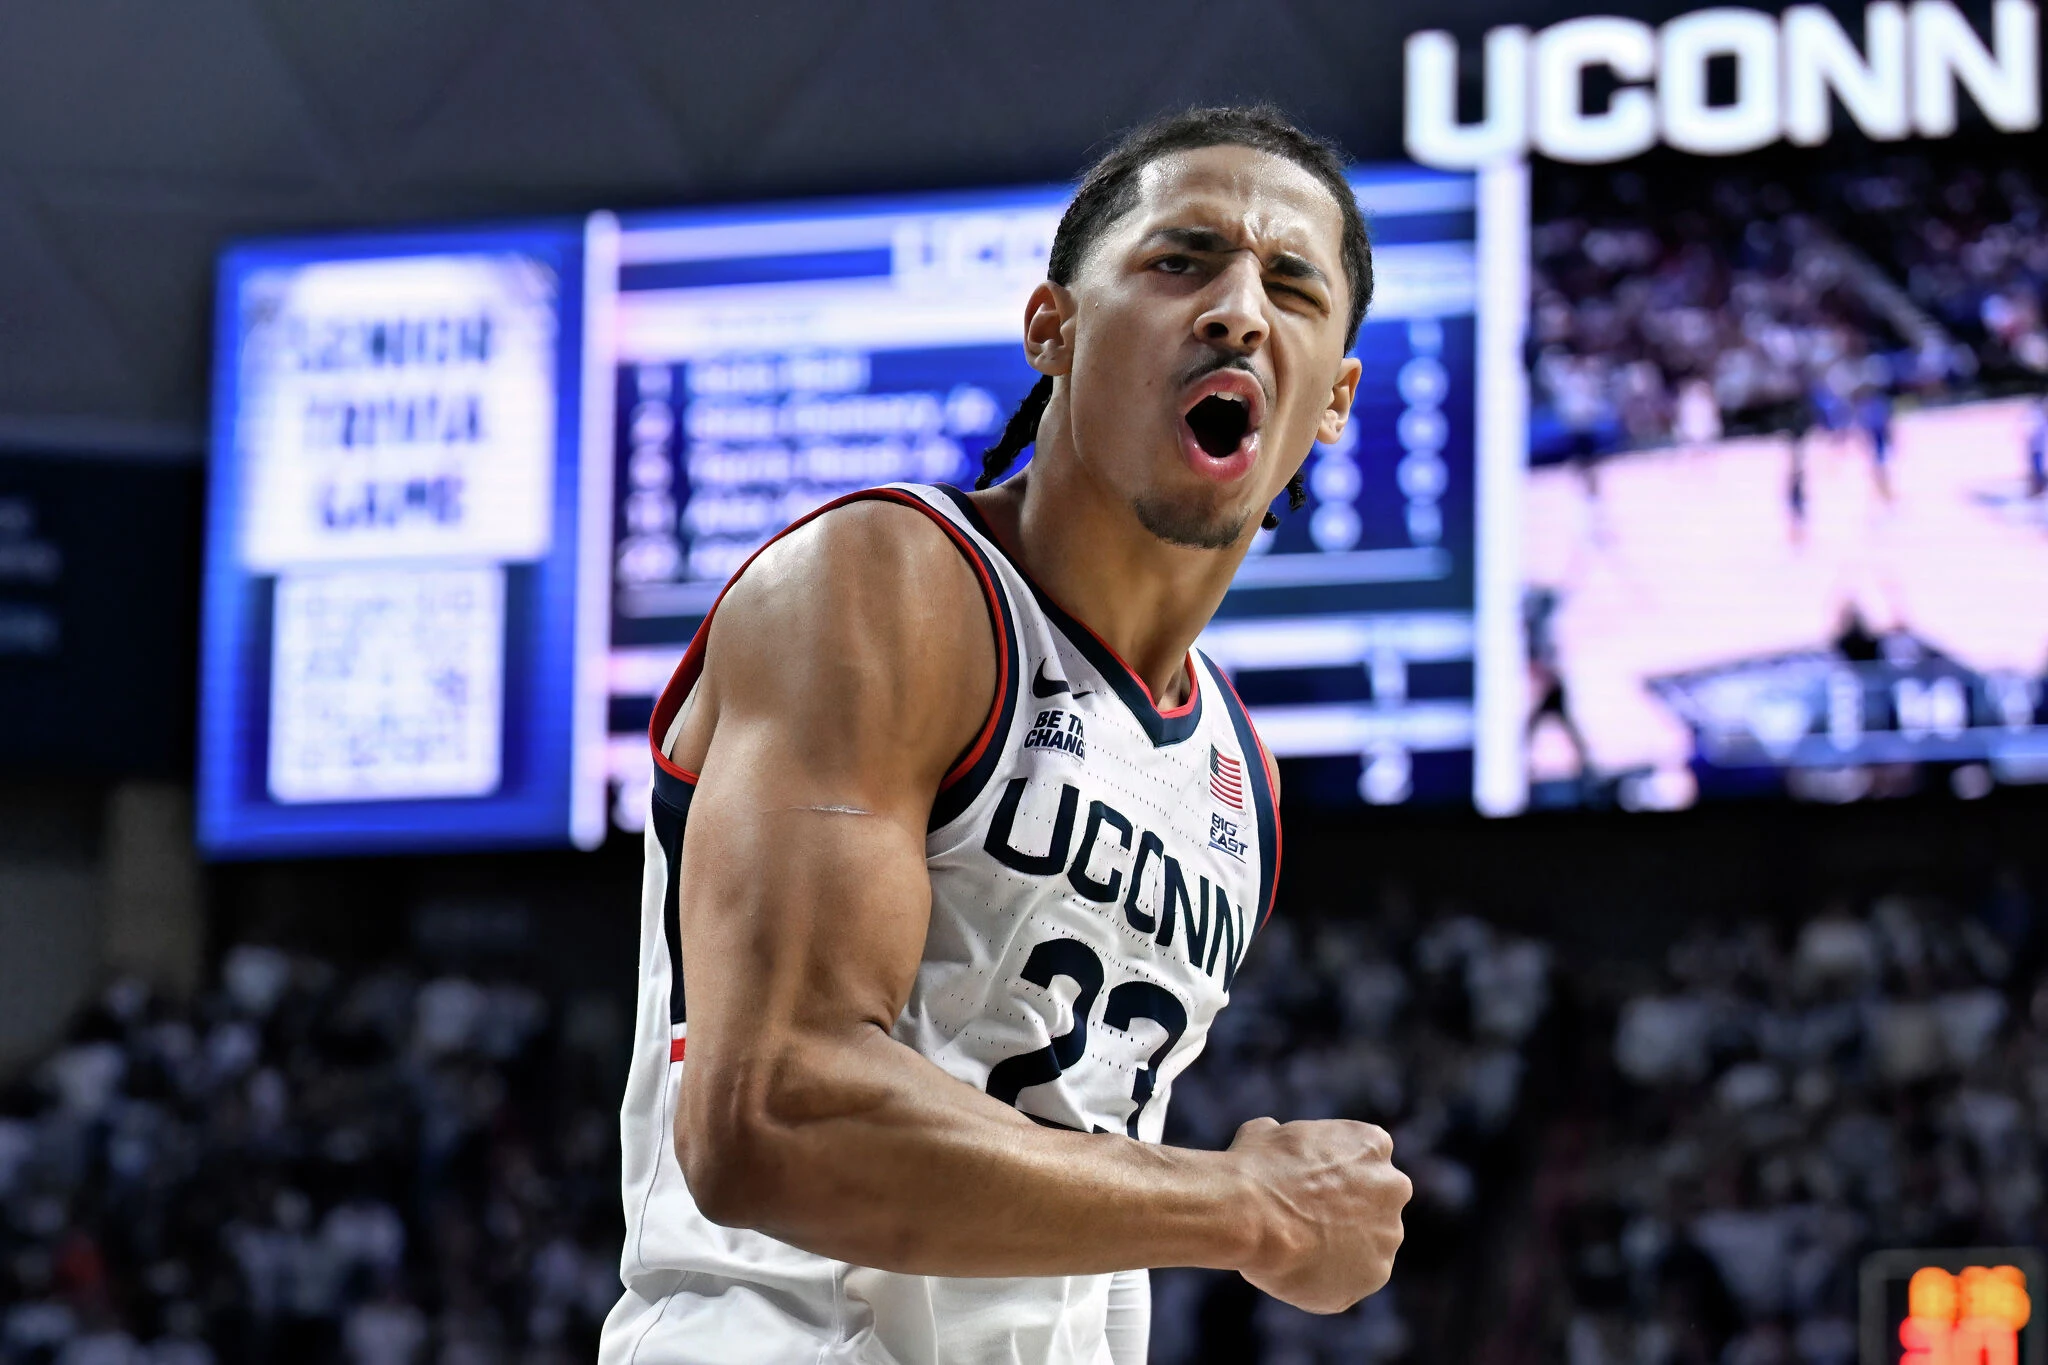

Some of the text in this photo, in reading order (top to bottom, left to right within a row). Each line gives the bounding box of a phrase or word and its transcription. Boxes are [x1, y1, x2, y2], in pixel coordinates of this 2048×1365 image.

[1404, 0, 2042, 170] UCONN
[1034, 710, 1085, 739] BE TH
[1024, 728, 1086, 760] CHANG
[1209, 825, 1248, 855] EAST
[1211, 812, 1238, 836] BIG
[983, 777, 1245, 993] UCONN
[986, 936, 1188, 1141] 23
